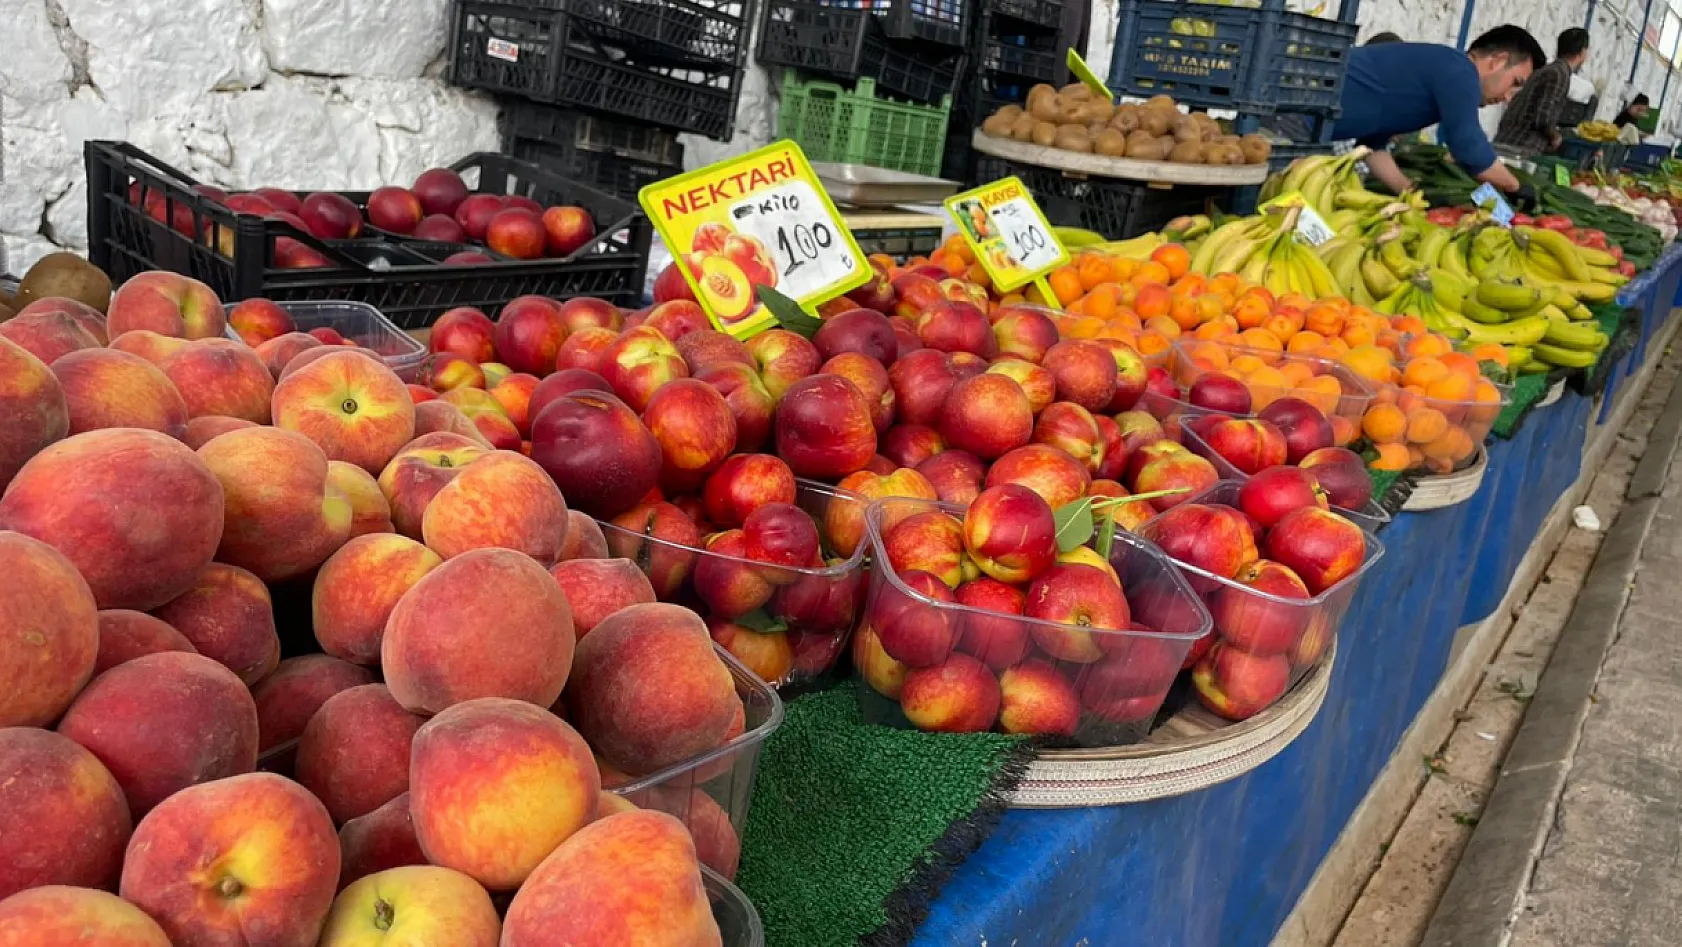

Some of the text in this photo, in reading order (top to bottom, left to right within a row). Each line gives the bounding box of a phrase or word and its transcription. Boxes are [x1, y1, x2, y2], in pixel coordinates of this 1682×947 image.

[662, 151, 797, 220] NEKTARİ
[777, 222, 831, 276] 100
[1013, 225, 1045, 261] 100
